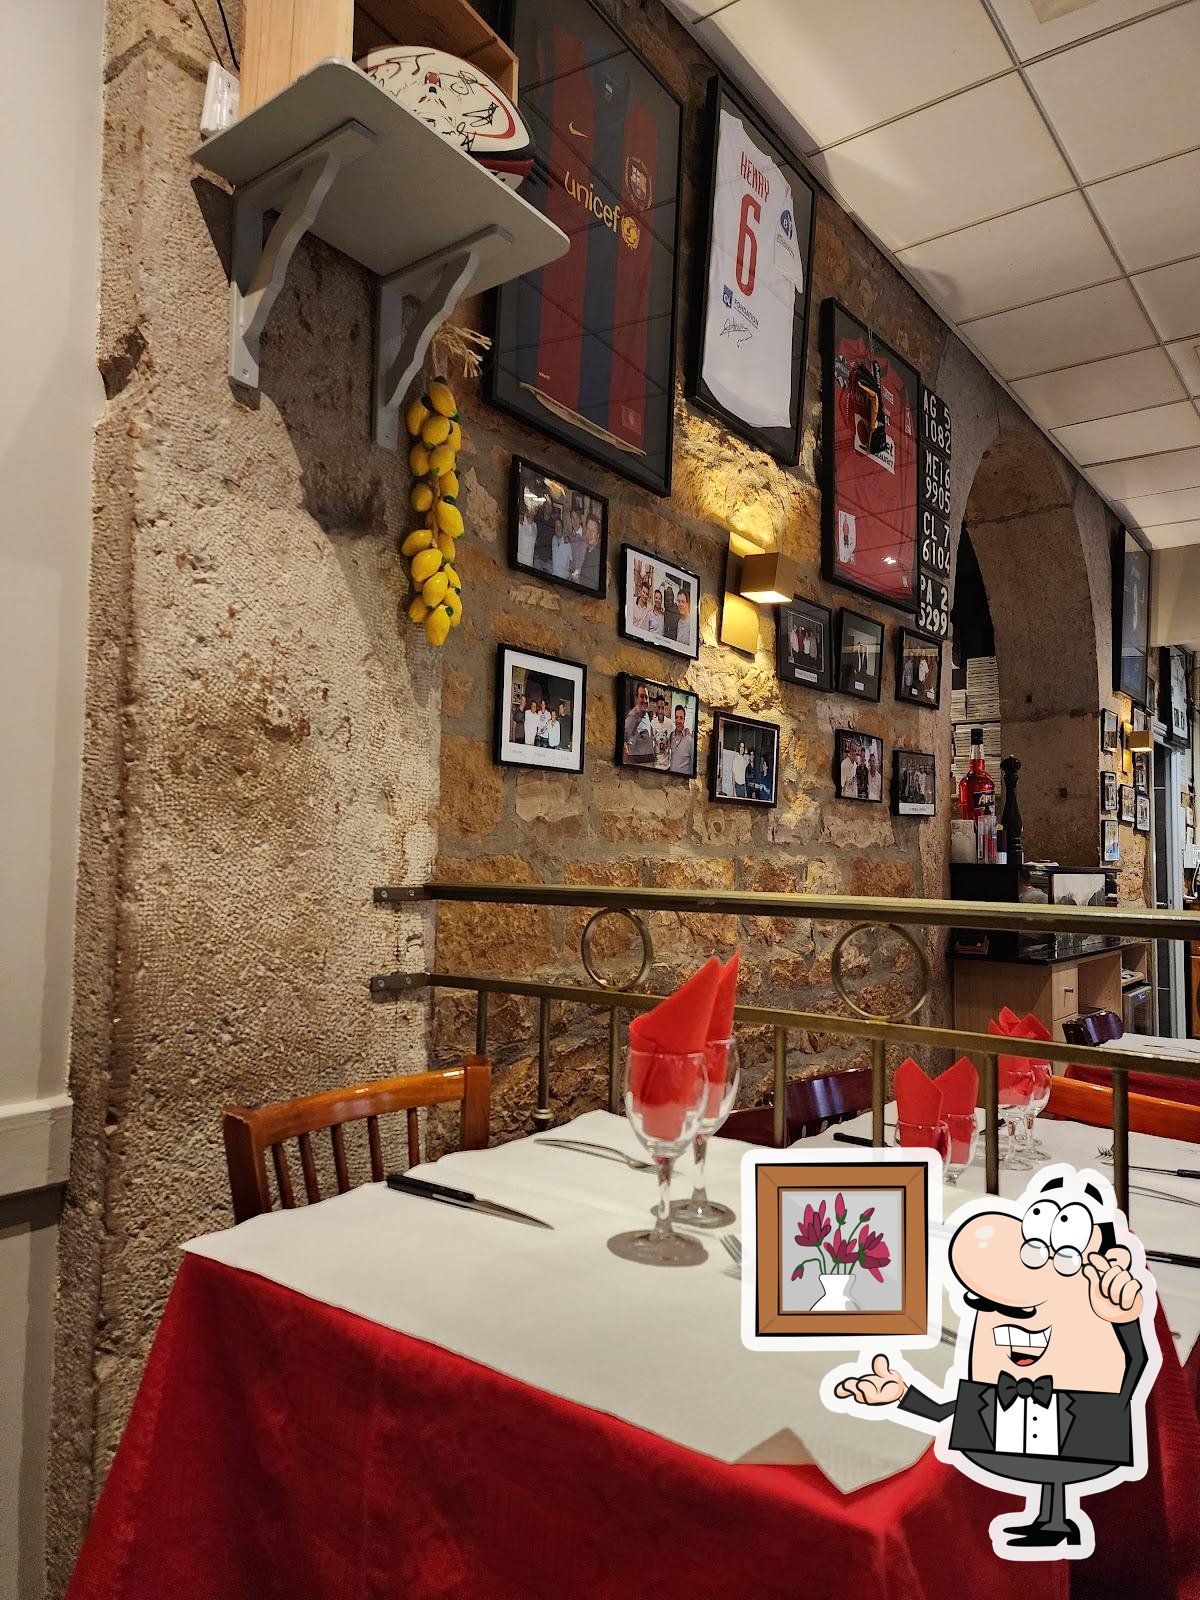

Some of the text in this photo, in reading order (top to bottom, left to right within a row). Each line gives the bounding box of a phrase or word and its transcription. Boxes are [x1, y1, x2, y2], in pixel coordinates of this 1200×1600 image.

[740, 150, 770, 202] HENRY
[564, 170, 621, 233] unicef
[735, 193, 762, 296] 6
[923, 389, 937, 419] AG
[943, 405, 951, 430] 5
[924, 413, 951, 455] 1082
[925, 449, 951, 490] ME16
[925, 476, 951, 514] 9905
[923, 511, 951, 548] CL 7
[922, 538, 950, 575] 6104
[920, 574, 948, 612] PA 2
[918, 601, 948, 636] 5299
